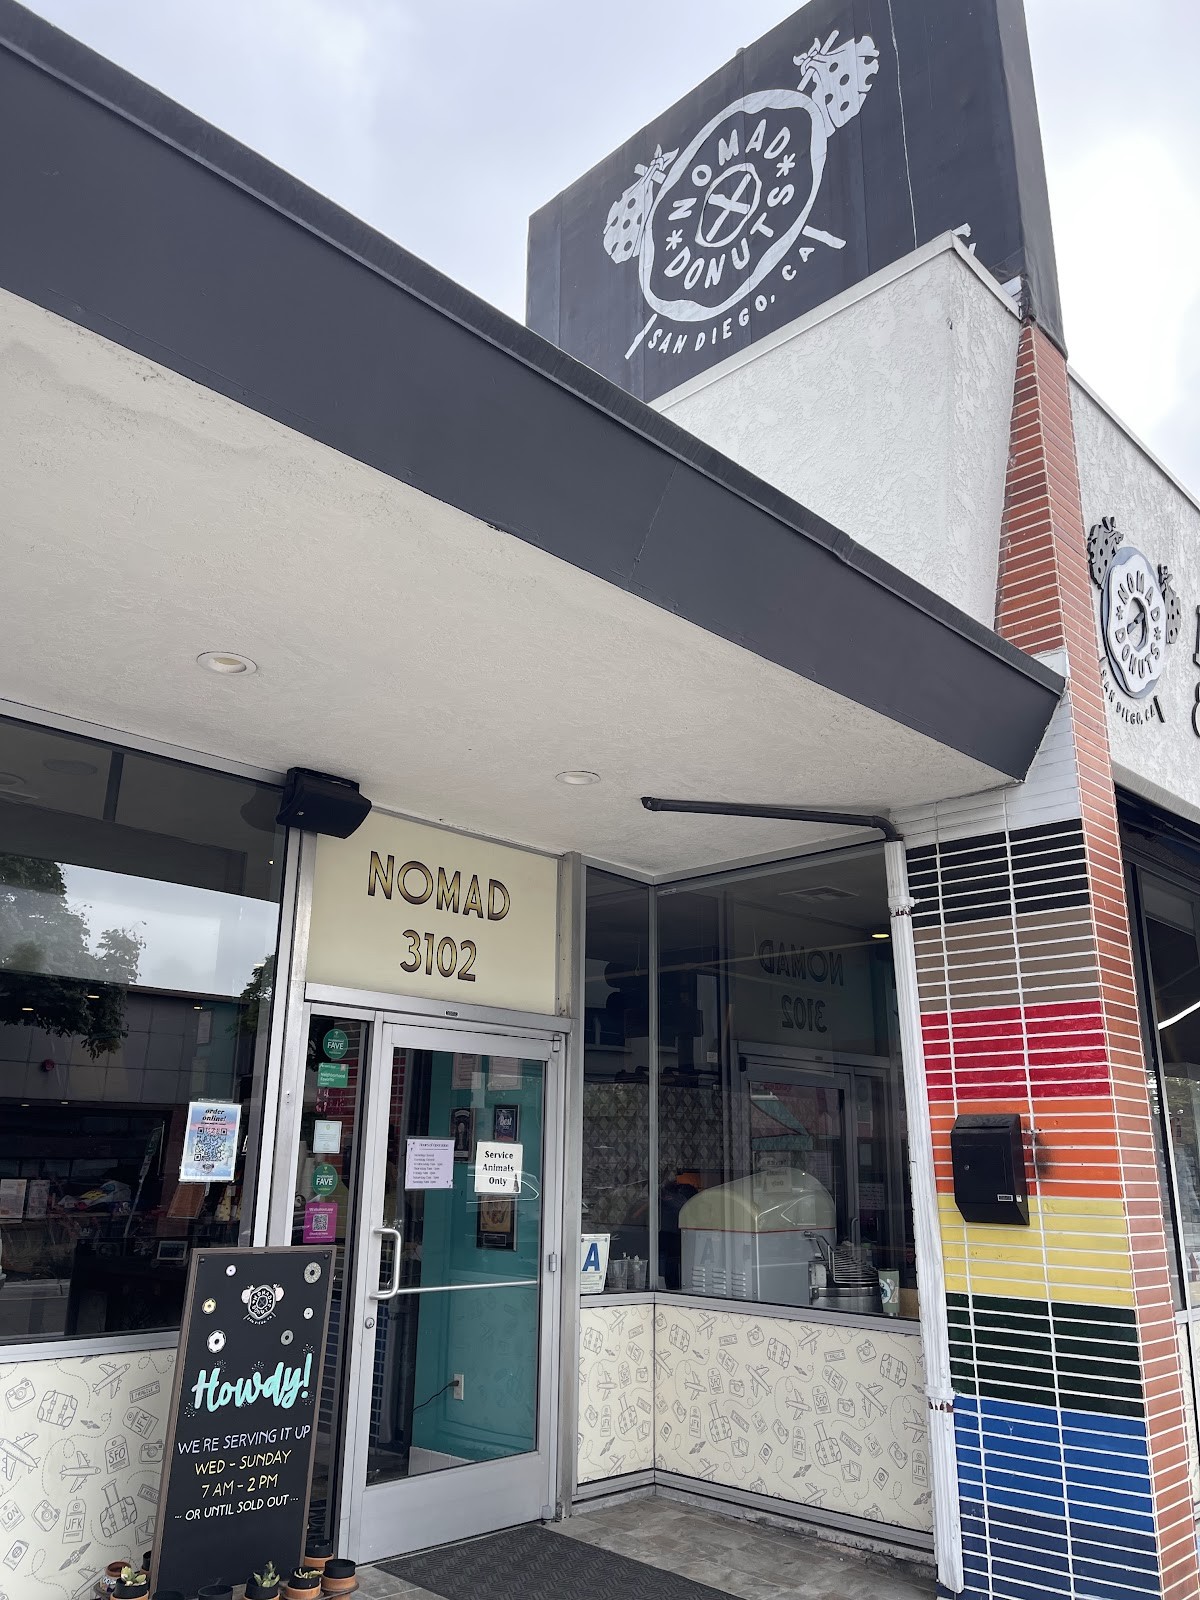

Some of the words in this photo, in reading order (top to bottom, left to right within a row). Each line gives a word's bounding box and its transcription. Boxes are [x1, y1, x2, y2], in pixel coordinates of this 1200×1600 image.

[668, 119, 791, 221] NOMAD
[664, 183, 795, 290] DONUTS
[648, 328, 687, 354] SAN
[781, 247, 814, 281] CA
[1118, 570, 1160, 622] NOMAD
[1115, 627, 1160, 679] DONUTS
[367, 850, 511, 921] NOMAD
[399, 929, 477, 982] 3102
[327, 1041, 344, 1050] FAVE
[484, 1150, 514, 1160] Service
[482, 1163, 515, 1173] Animals
[316, 1178, 333, 1186] FAVE
[488, 1177, 508, 1187] Only
[581, 1242, 601, 1272] A
[191, 1352, 313, 1412] Howdy!
[134, 1413, 149, 1433] JFK
[178, 1437, 219, 1455] WE'RE
[223, 1429, 277, 1449] SERVING
[280, 1427, 292, 1441] IT
[294, 1424, 311, 1440] UP
[108, 1447, 126, 1464] SFO
[195, 1459, 225, 1475] WED
[239, 1450, 292, 1470] SUNDAY
[201, 1484, 210, 1498] 7
[212, 1480, 234, 1497] AM
[247, 1477, 256, 1492] 2
[258, 1474, 278, 1490] PM
[1, 1506, 19, 1525] LON
[185, 1508, 201, 1521] OR
[204, 1503, 234, 1518] UNTIL
[236, 1498, 264, 1514] SOLD
[65, 1518, 83, 1531] JFK
